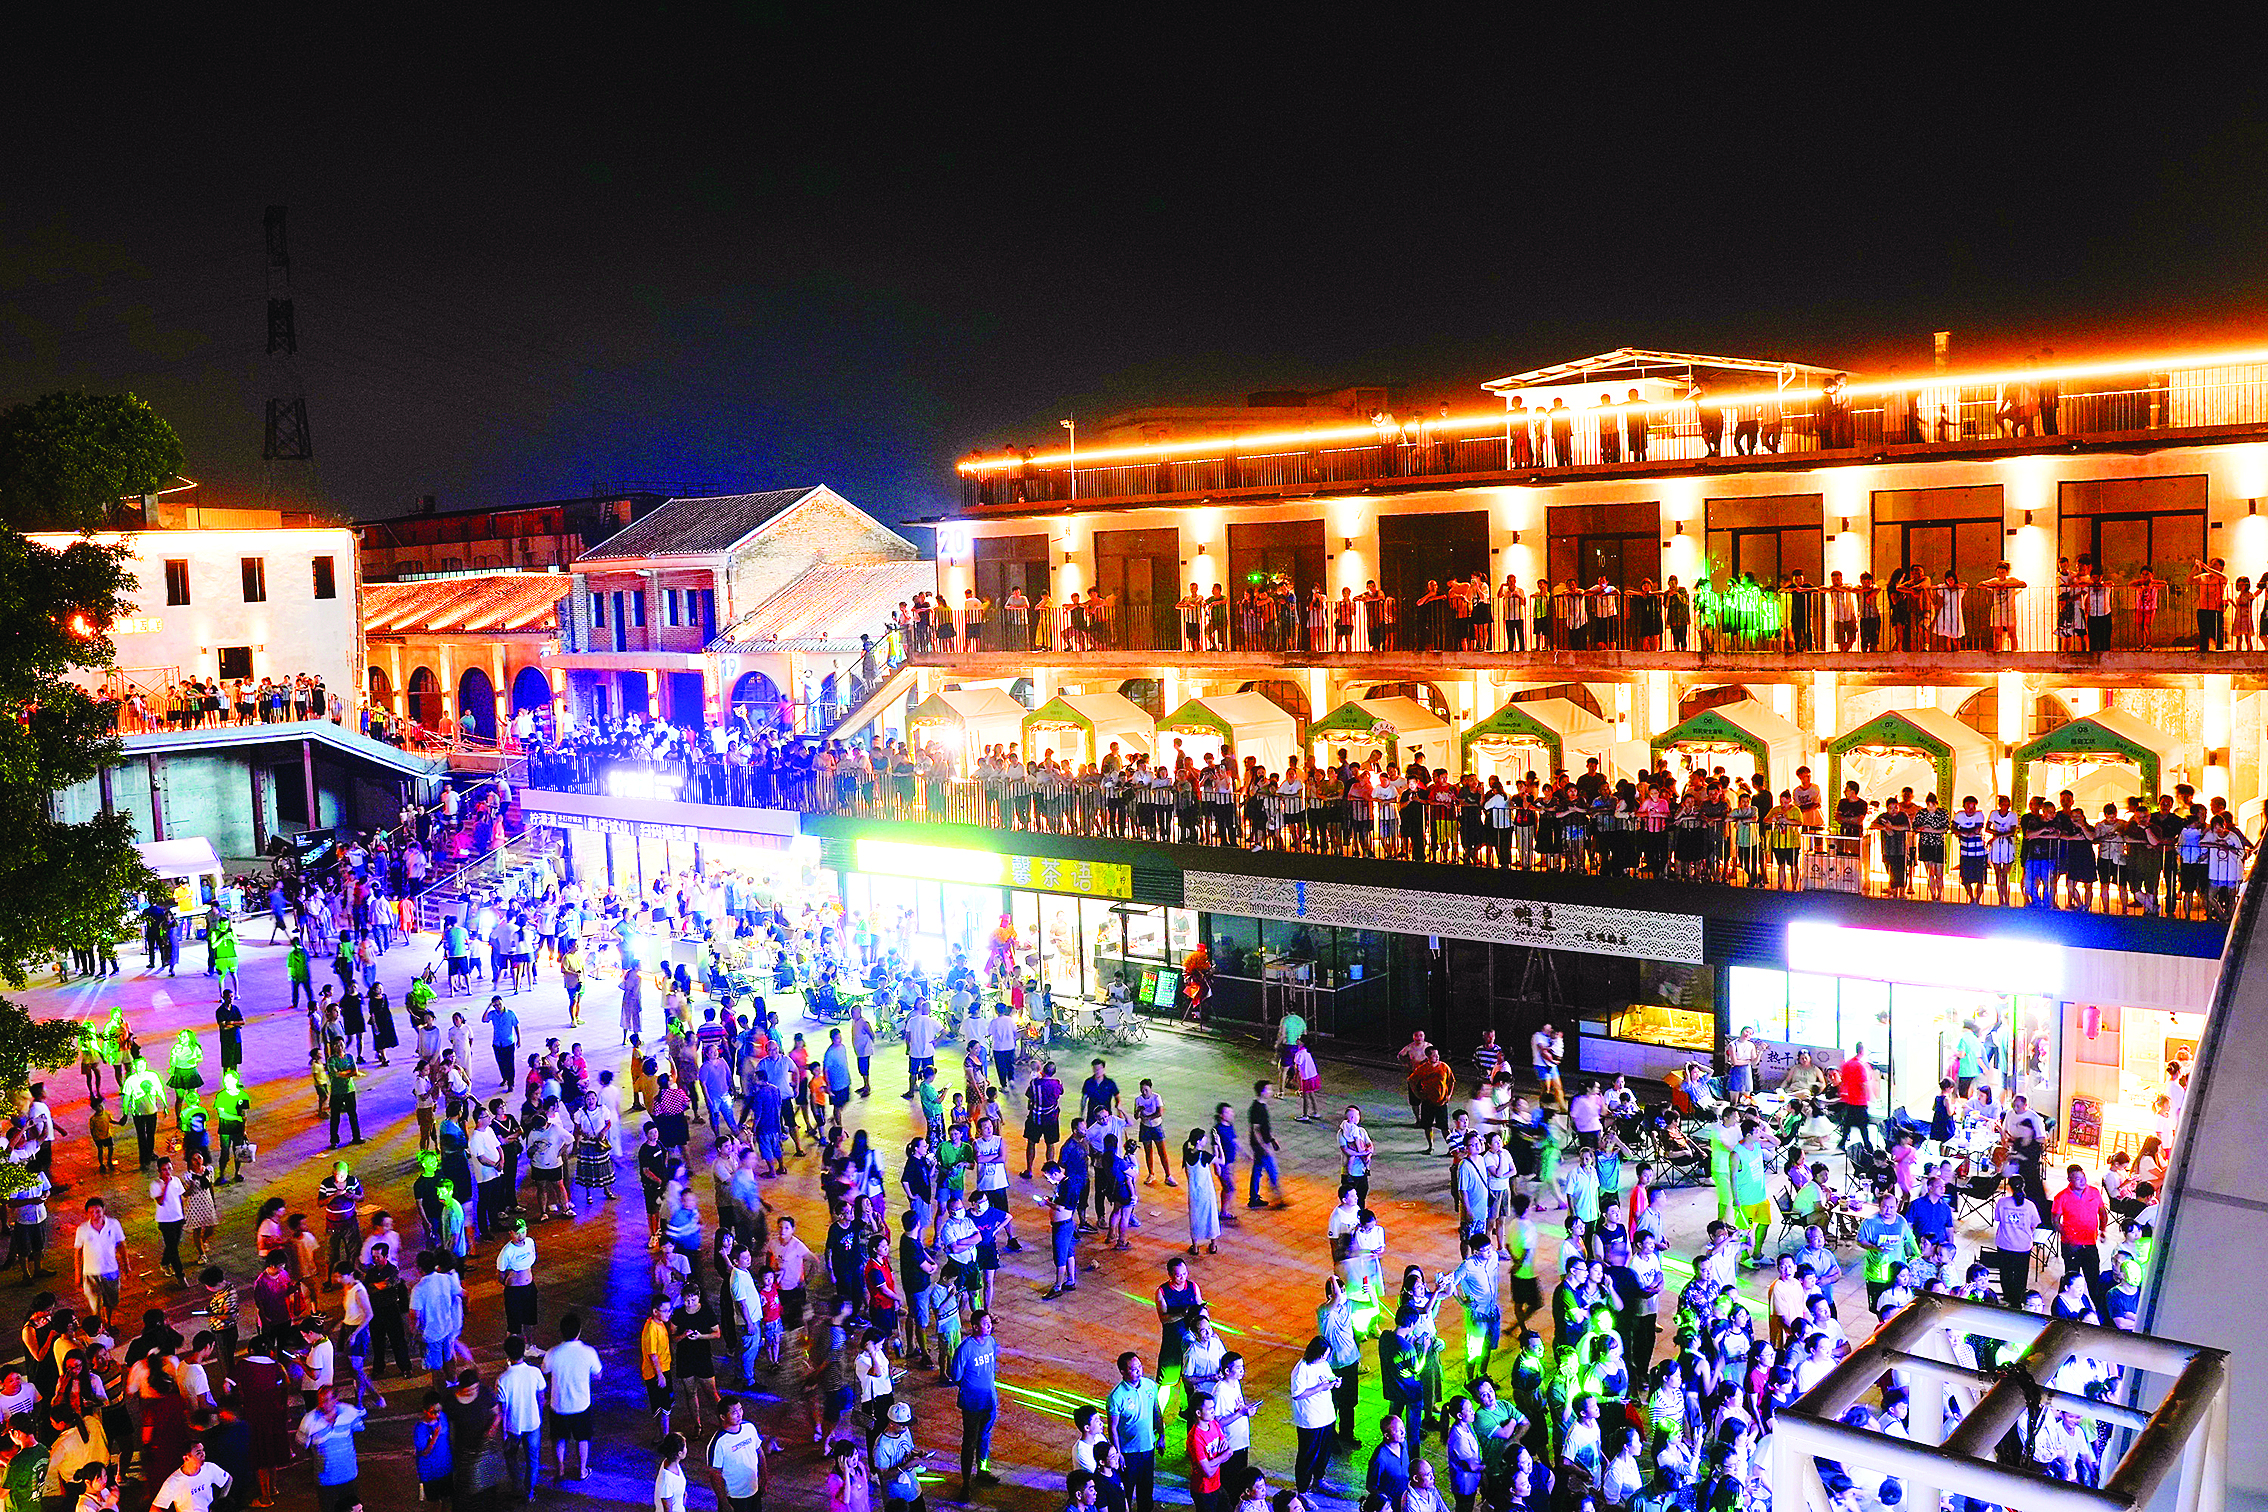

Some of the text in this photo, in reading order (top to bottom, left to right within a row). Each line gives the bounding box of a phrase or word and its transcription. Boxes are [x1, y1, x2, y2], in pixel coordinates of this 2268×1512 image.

[939, 529, 964, 554] 20
[1884, 721, 1894, 729] 07
[2077, 726, 2089, 734] 08
